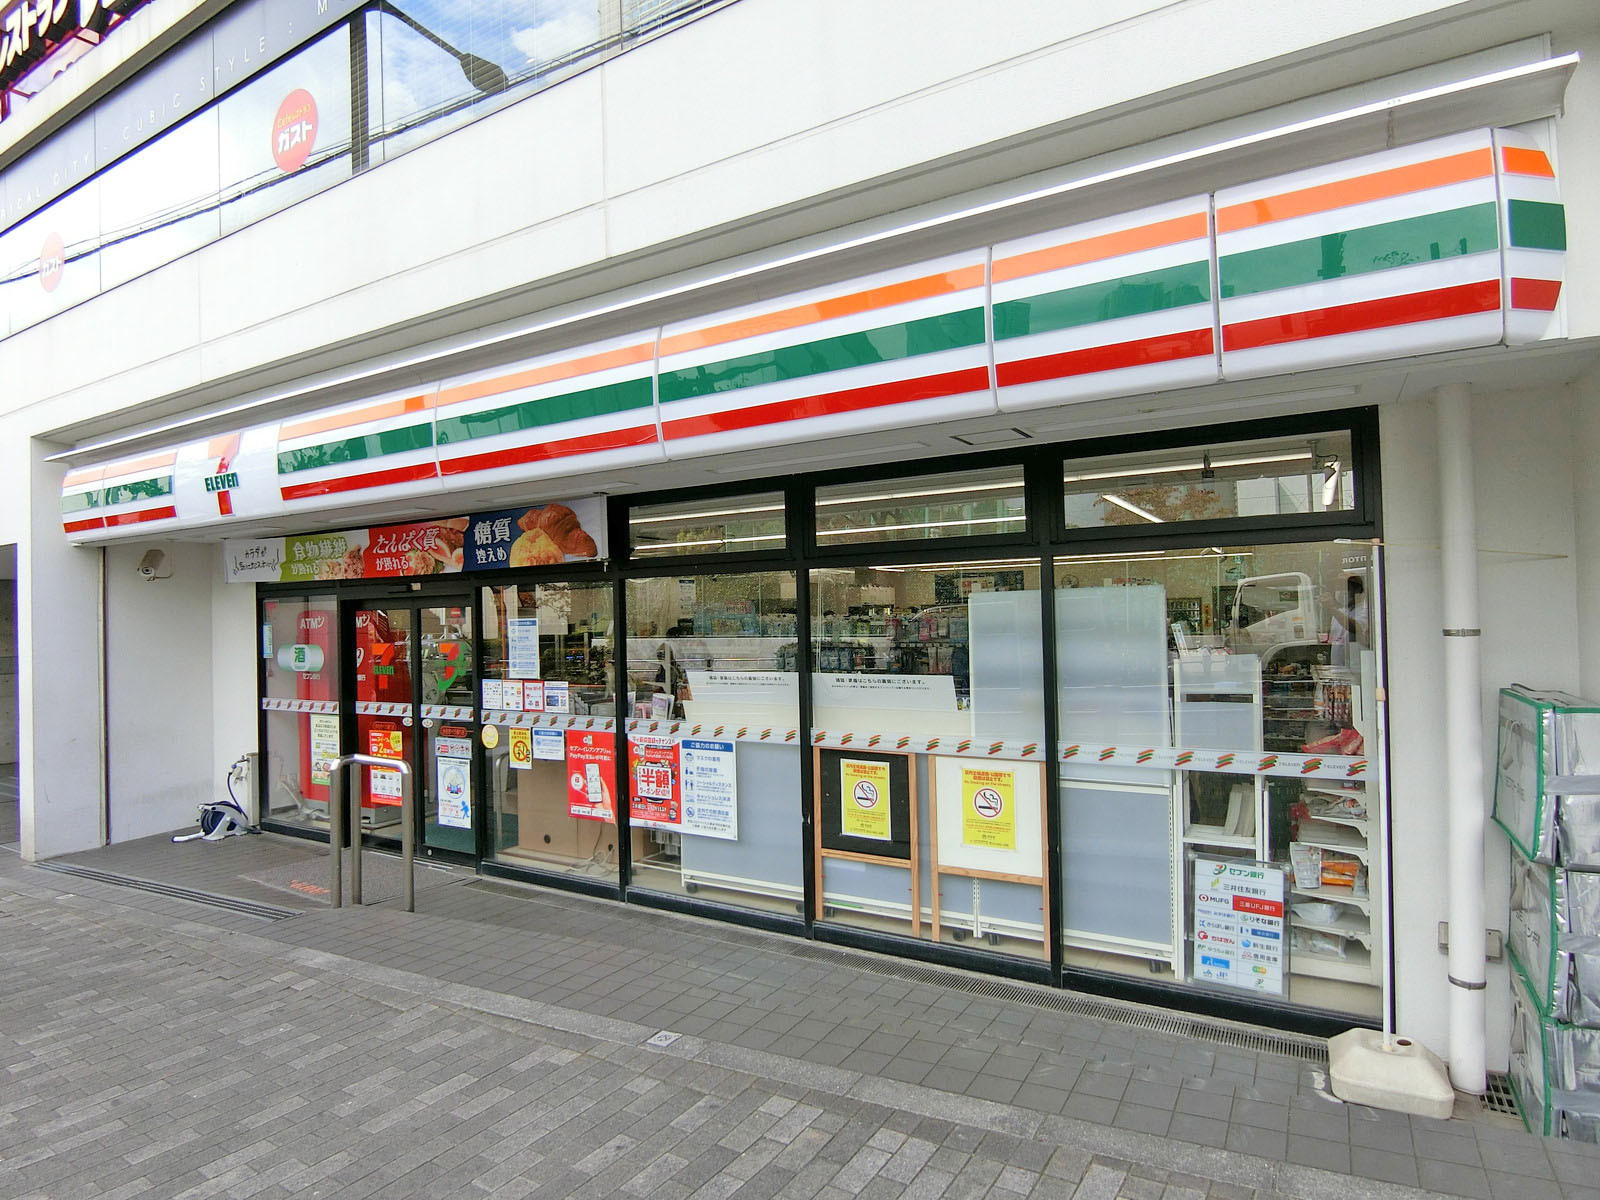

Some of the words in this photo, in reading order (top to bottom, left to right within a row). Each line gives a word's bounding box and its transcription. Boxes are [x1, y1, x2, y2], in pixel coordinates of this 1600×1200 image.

[199, 36, 266, 91] STYLE
[277, 119, 313, 154] ガスト
[473, 516, 512, 546] 糖質
[372, 526, 441, 555] たんぱく質
[293, 538, 347, 561] 食物繊維
[475, 546, 507, 565] 控えめ
[290, 560, 320, 576] が摂れる
[375, 555, 409, 572] が摂れる
[294, 646, 306, 663] 酒
[690, 742, 725, 750] ご協力のお願い
[640, 768, 670, 788] 半額
[1229, 868, 1265, 879] セブン銀行
[1223, 883, 1266, 896] 三井住友銀行
[1209, 896, 1230, 904] MUFG
[1239, 900, 1276, 912] 三菱UFJ銀行
[1249, 916, 1280, 927] りそな銀行
[1211, 935, 1235, 944] ちばぎん
